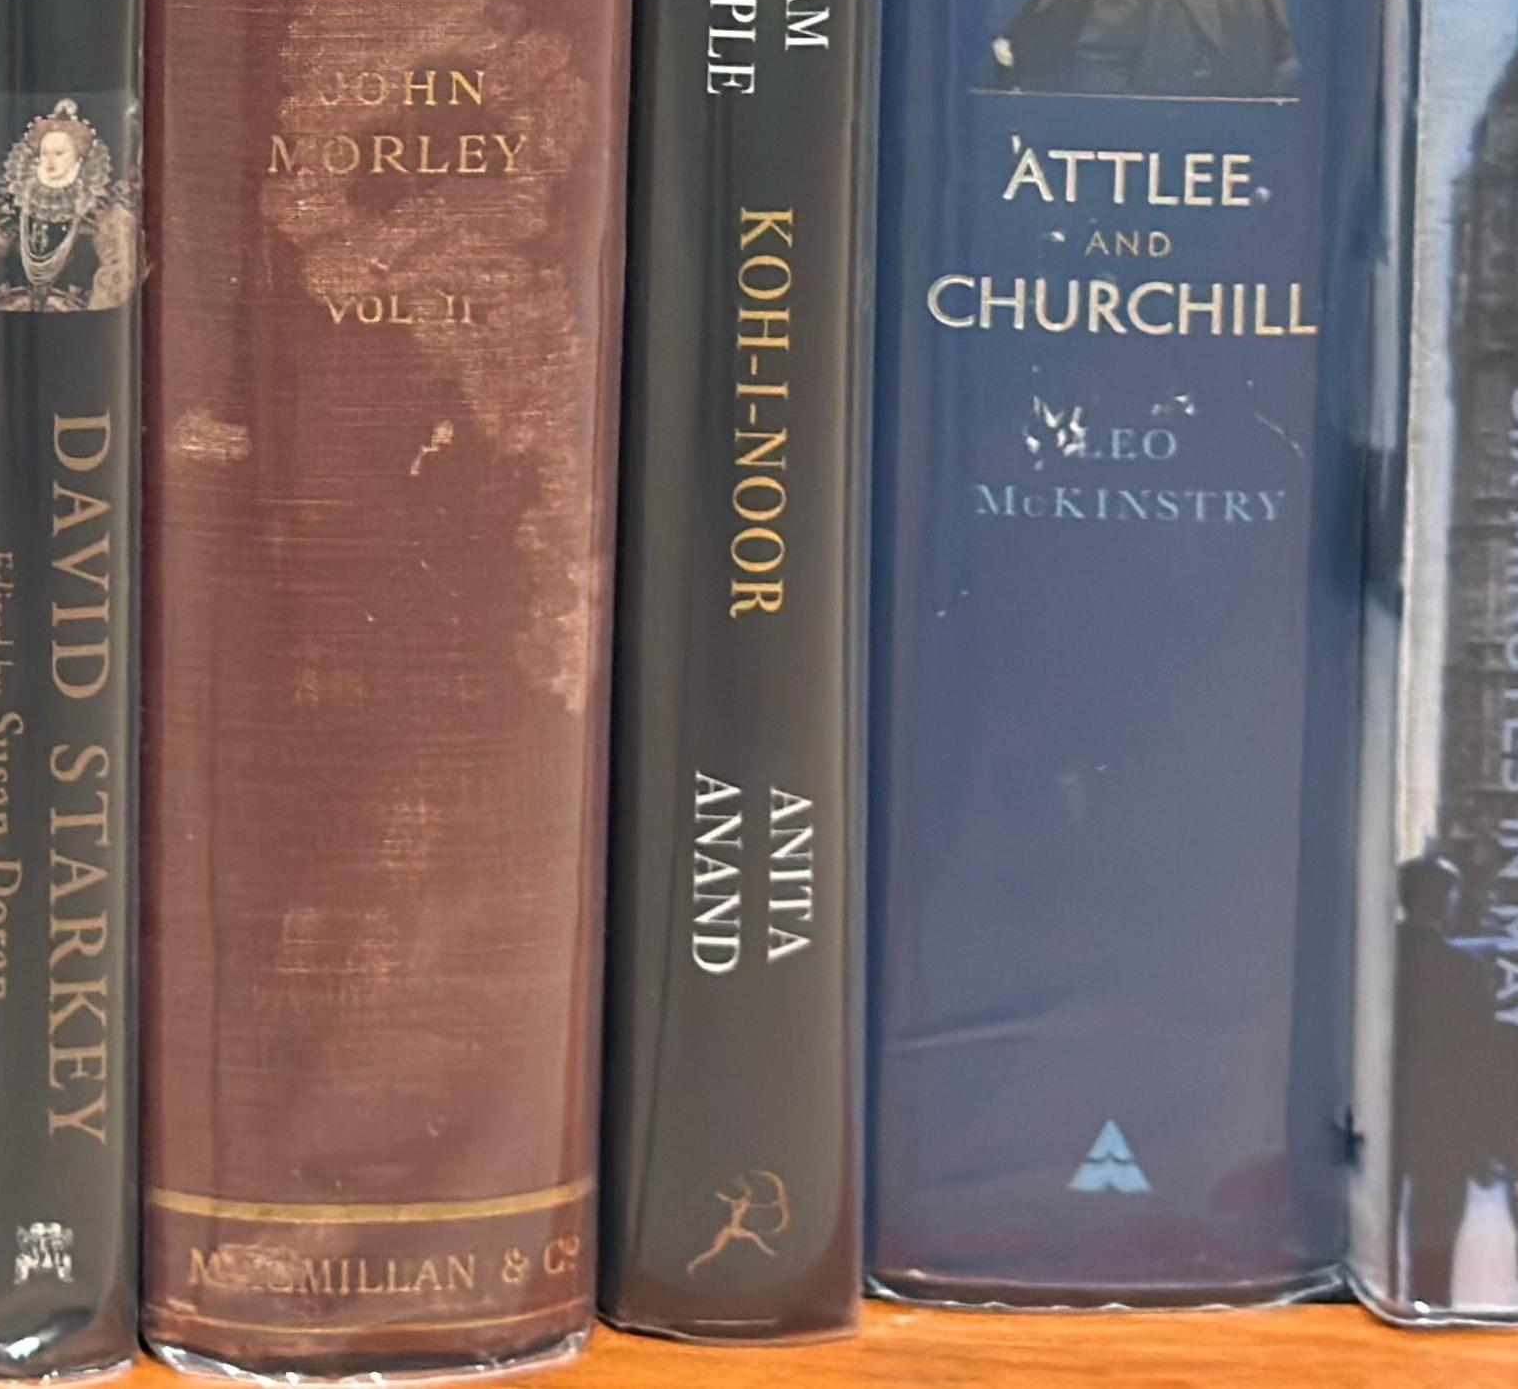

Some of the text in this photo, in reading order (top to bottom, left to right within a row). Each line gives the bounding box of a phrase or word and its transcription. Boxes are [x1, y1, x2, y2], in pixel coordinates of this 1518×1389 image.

[320, 71, 485, 106] JOHN
[268, 135, 526, 174] MORLEY
[1002, 148, 1251, 206] ATTLEE
[1085, 231, 1173, 257] AND
[926, 274, 1318, 335] CHURCHILL
[730, 206, 795, 618] KOH-I-NOOR
[1070, 427, 1176, 459] LEO
[976, 485, 1285, 521] McKINSTRY
[48, 413, 111, 1145] DAVID STARKEY
[692, 770, 744, 975] ANAND
[767, 786, 814, 961] ANITA
[501, 1248, 529, 1284] &
